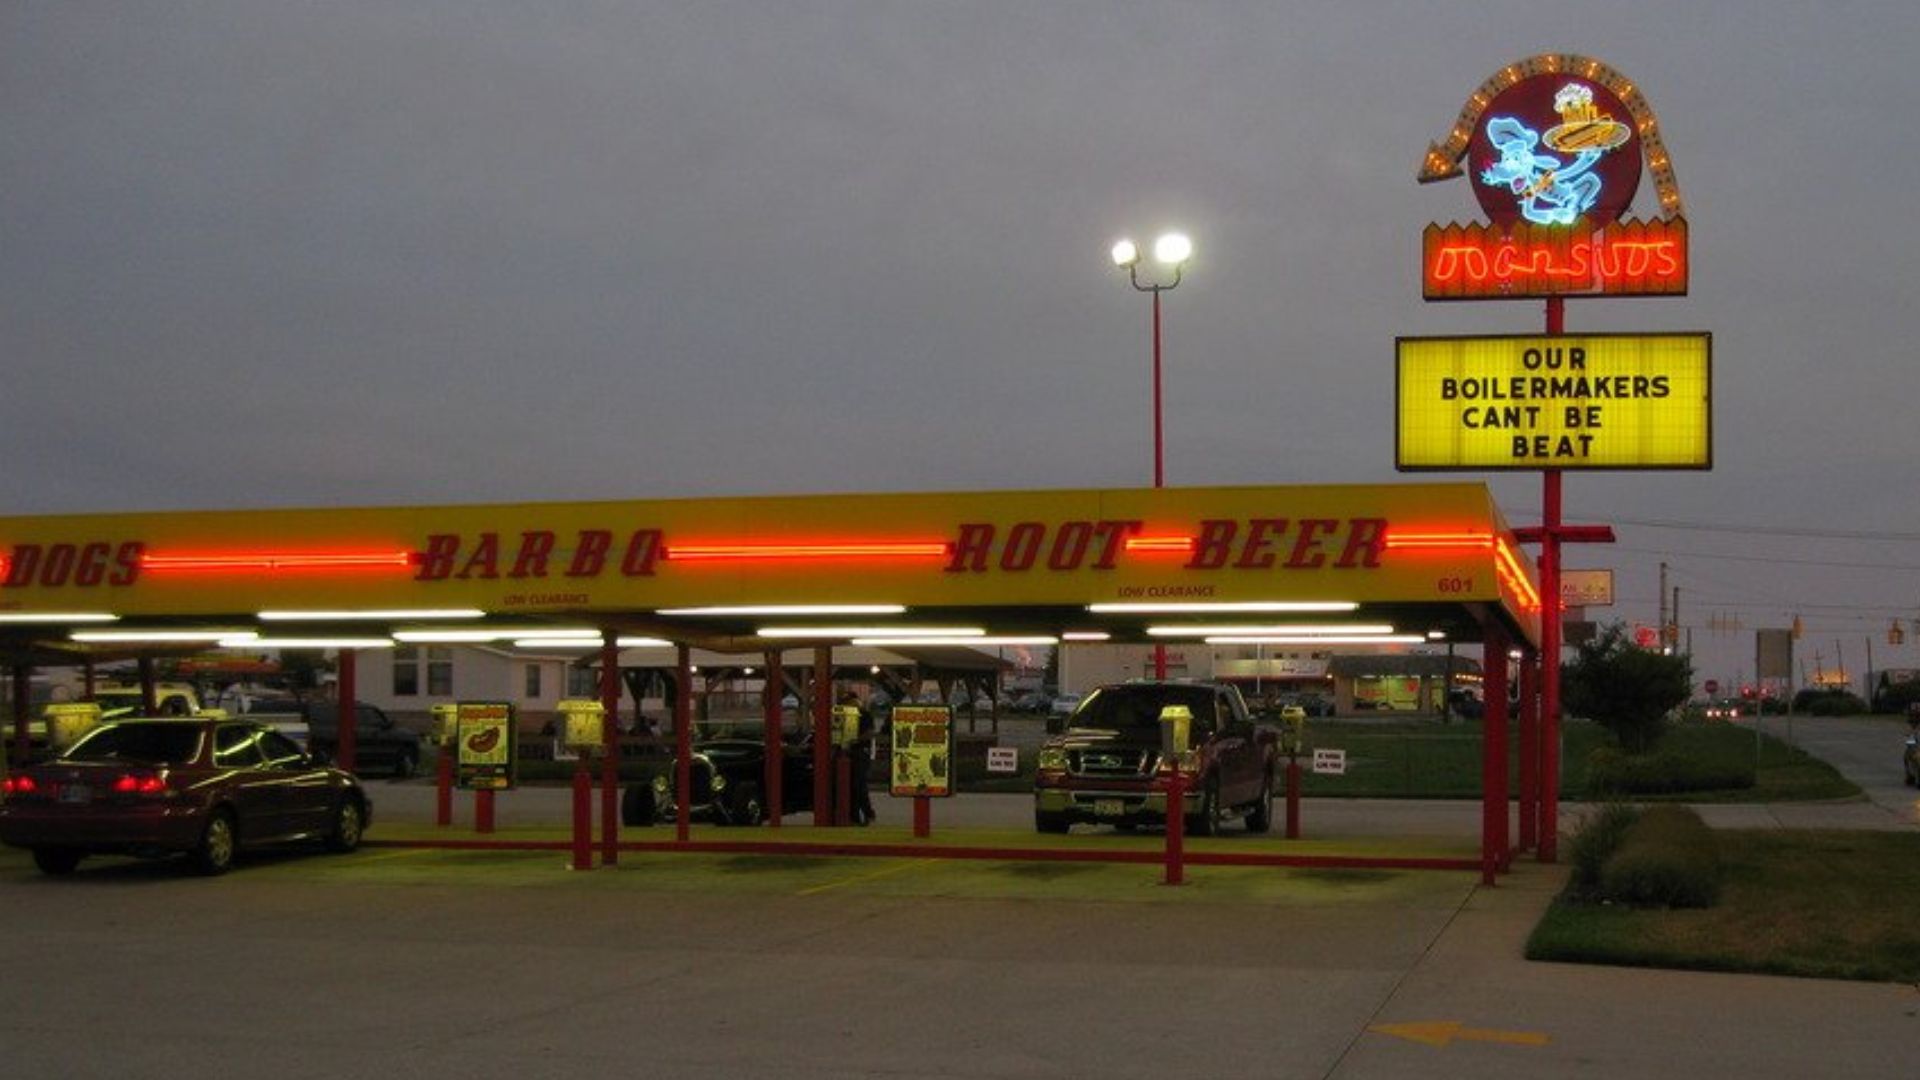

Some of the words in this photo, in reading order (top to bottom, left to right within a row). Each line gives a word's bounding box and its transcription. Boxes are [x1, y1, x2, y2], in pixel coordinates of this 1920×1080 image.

[1522, 347, 1587, 370] OUR
[1441, 376, 1671, 400] BOILERMAKERS
[1462, 405, 1541, 429] CANT
[1564, 405, 1603, 428] BE
[1512, 434, 1594, 458] BEAT
[944, 520, 1143, 572] ROOT
[1184, 518, 1388, 569] BEER
[1, 541, 146, 586] DOGS
[1118, 586, 1145, 597] LOW
[1148, 585, 1216, 597] CLEARANCE
[1438, 577, 1472, 592] 601
